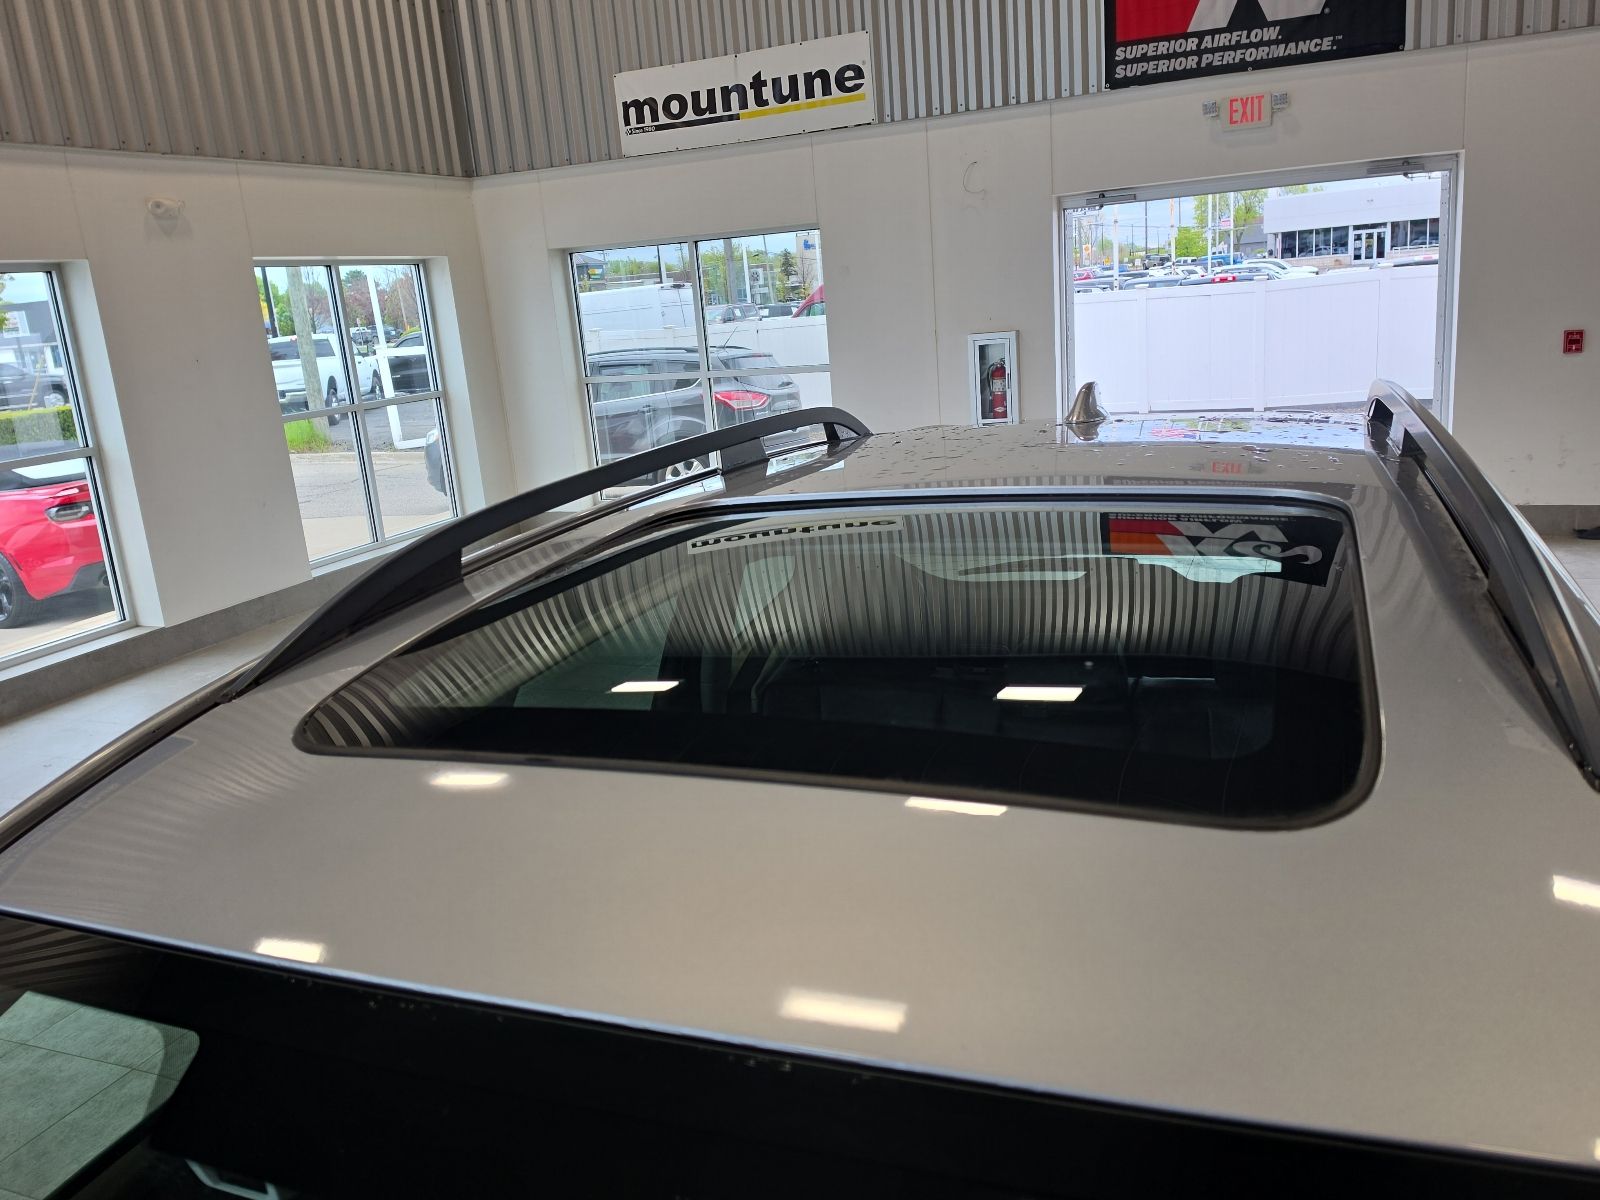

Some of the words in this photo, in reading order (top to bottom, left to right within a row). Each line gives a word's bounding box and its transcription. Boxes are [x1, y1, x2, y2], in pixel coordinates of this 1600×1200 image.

[1115, 38, 1198, 60] SUPERIOR
[1200, 26, 1282, 49] AIRFLOW.
[1115, 56, 1198, 78] SUPERIOR
[622, 63, 865, 127] mountune
[1229, 95, 1264, 124] EXIT
